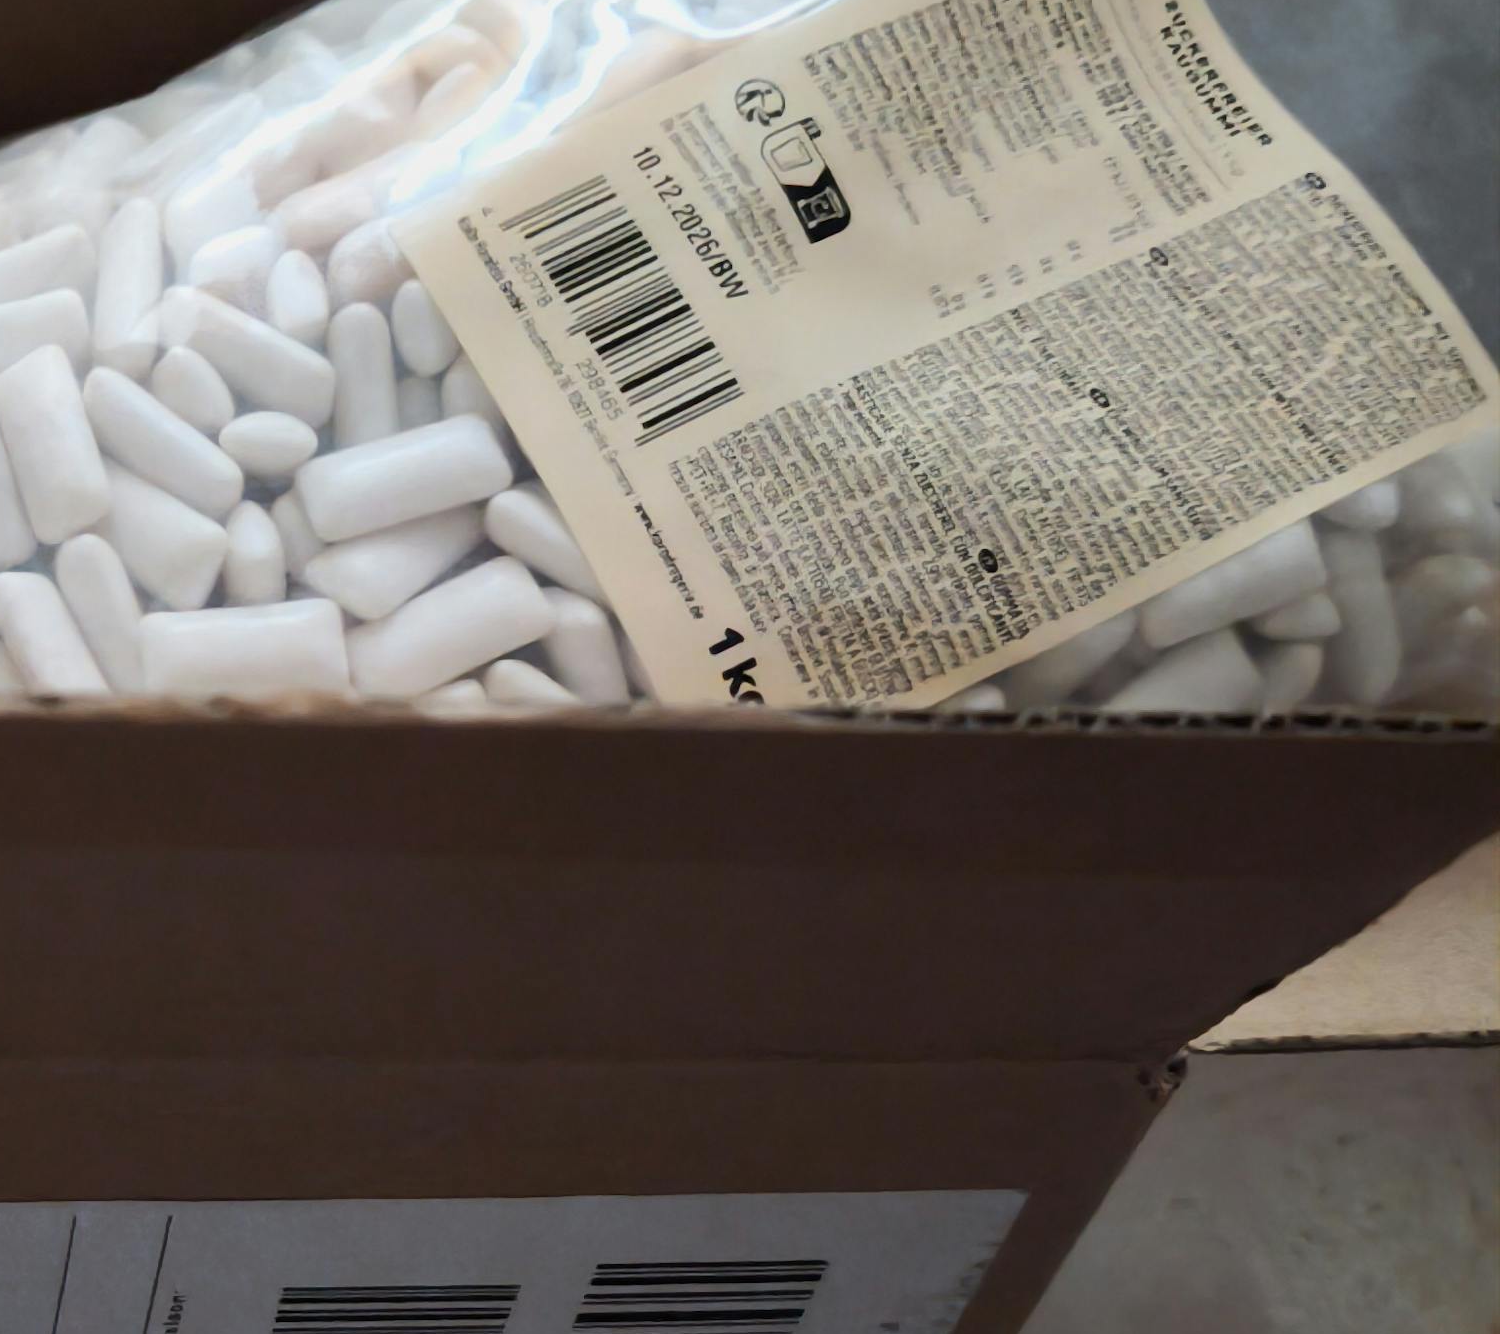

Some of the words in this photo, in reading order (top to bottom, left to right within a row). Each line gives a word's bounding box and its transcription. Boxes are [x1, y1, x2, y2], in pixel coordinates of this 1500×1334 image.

[631, 145, 750, 302] 10.12.2026/BW
[574, 357, 624, 421] 298465
[707, 627, 745, 656] 1
